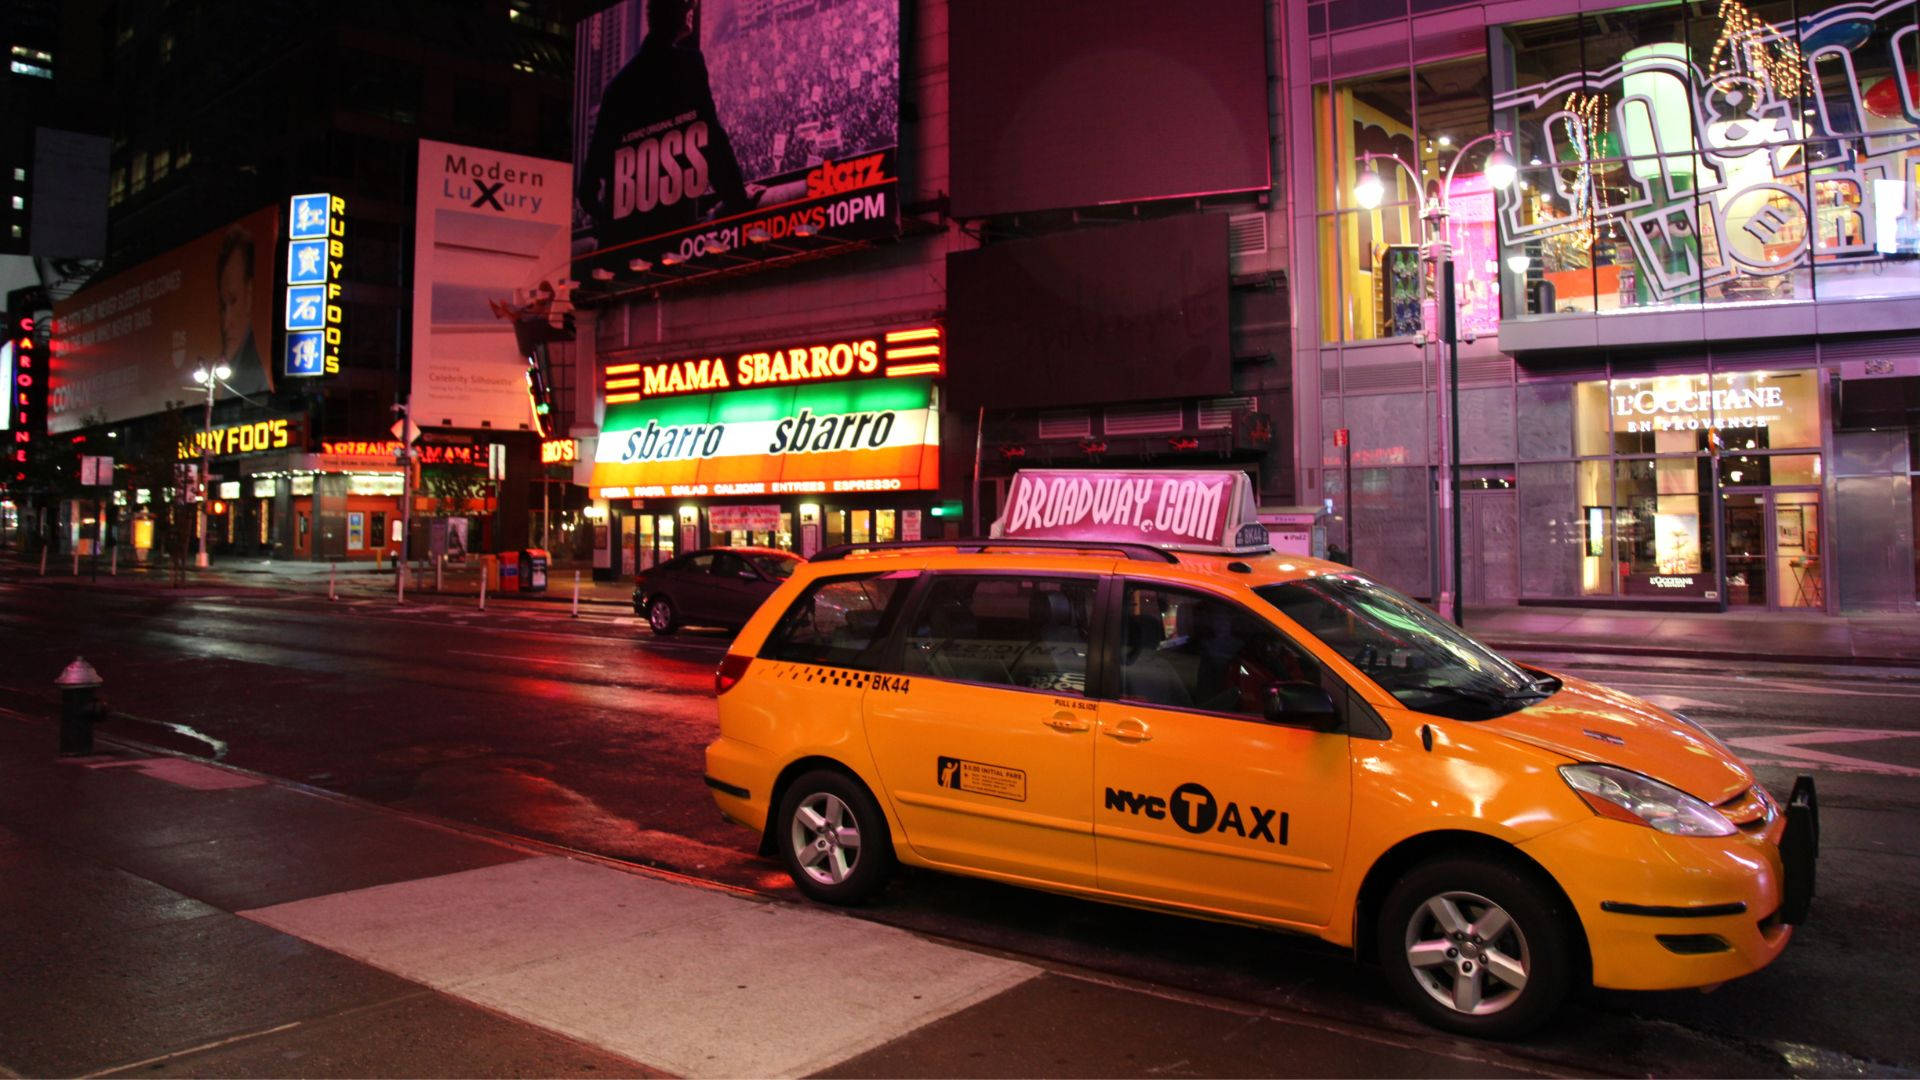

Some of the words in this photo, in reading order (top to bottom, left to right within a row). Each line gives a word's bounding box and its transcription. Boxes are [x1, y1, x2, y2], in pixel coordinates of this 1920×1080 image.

[445, 154, 544, 187] Modern
[613, 120, 708, 220] BOSS
[443, 178, 542, 213] LuXury
[643, 358, 729, 395] MAMA
[738, 340, 877, 386] SBARRO'S
[1616, 386, 1784, 416] L'OCCITANE
[227, 419, 288, 454] FOO'S
[621, 421, 725, 461] sbarro
[770, 410, 895, 453] sbarro
[1627, 421, 1652, 432] EN
[1661, 416, 1767, 432] PROVENCE
[671, 484, 709, 497] SALAD
[833, 478, 901, 491] ESPRESSO
[1009, 476, 1224, 541] BROADWAY.COM
[1105, 787, 1166, 820] NYC
